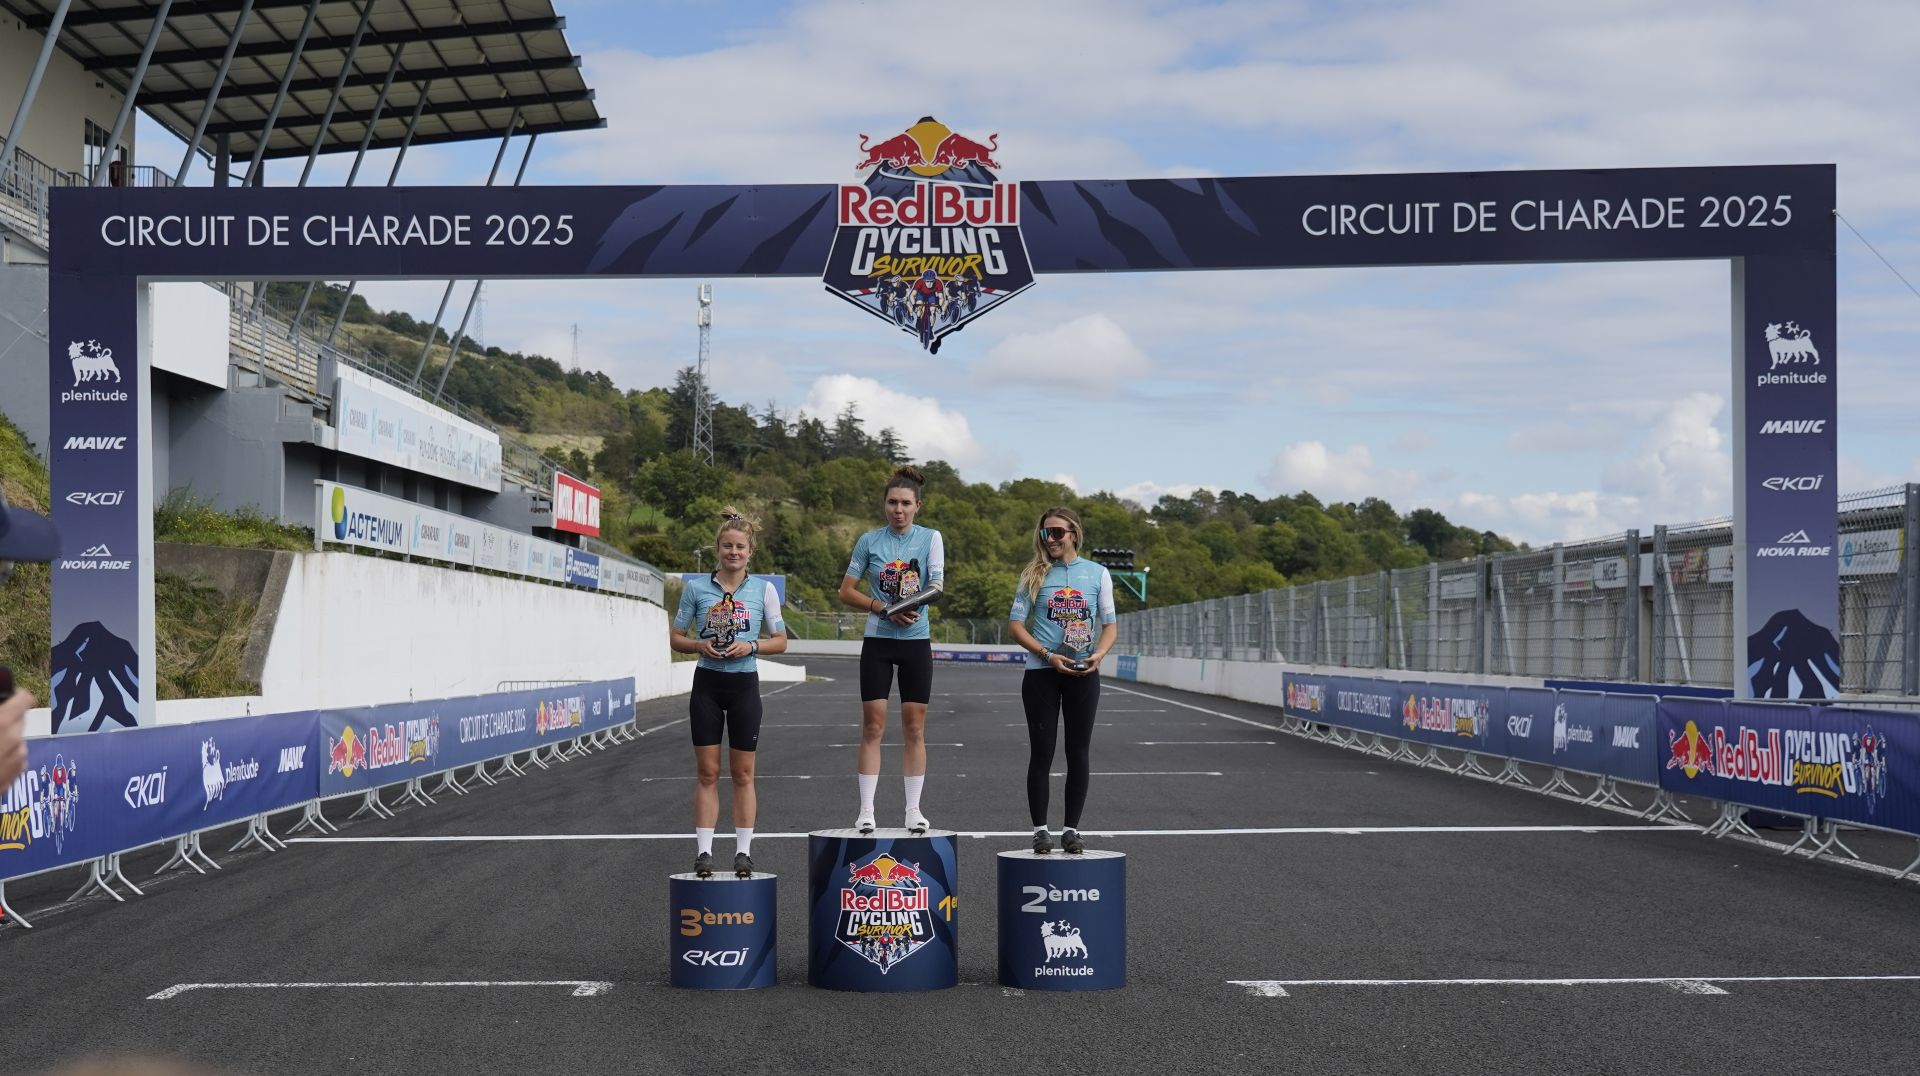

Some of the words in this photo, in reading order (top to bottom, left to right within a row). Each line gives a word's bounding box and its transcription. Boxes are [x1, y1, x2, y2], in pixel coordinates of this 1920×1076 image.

[841, 184, 926, 225] Red
[934, 182, 1018, 225] Bull
[1301, 202, 1440, 237] CIRCUIT
[1453, 201, 1497, 234] DE
[1510, 197, 1686, 233] CHARADE
[1699, 194, 1793, 229] 2025
[101, 214, 235, 247] CIRCUIT
[247, 215, 290, 246] DE
[302, 214, 472, 247] CHARADE
[485, 214, 575, 246] 2025
[850, 227, 1009, 277] CYCLING
[867, 253, 984, 281] SURVIVOR
[1757, 371, 1828, 387] plenitude
[61, 389, 129, 404] plenitude
[1759, 419, 1827, 434] MAVIC
[63, 436, 127, 450] MAVIC
[348, 511, 403, 547] ACTEMIUM
[1756, 547, 1796, 557] NOVA
[1797, 546, 1831, 556] RIDE
[61, 560, 97, 570] NOVA
[99, 560, 132, 570] RIDE
[880, 571, 898, 581] Red
[1048, 599, 1067, 608] Red
[1068, 598, 1088, 608] Bull
[1051, 607, 1083, 618] CYCLING
[460, 715, 481, 744] CIRCUIT
[481, 714, 489, 739] DE
[490, 710, 514, 738] CHARADE
[1421, 697, 1437, 730] Red
[1435, 698, 1452, 732] Bull
[1451, 699, 1479, 735] CYCLING
[369, 724, 389, 770] Red
[386, 721, 405, 766] Bull
[1567, 723, 1594, 744] plenitude
[1612, 725, 1640, 749] MAVIC
[278, 745, 307, 774] MAVIC
[1714, 725, 1748, 782] Red
[1746, 728, 1783, 786] Bull
[1784, 729, 1857, 794] CYCLING
[225, 758, 260, 783] plenitude
[1792, 759, 1845, 796] SURVIVOR
[841, 888, 885, 911] Red
[887, 887, 928, 911] Bull
[1021, 883, 1100, 914] 2ème
[681, 906, 755, 937] 3ème
[846, 911, 924, 936] CYCLING
[857, 923, 913, 938] SURVIVOR
[1034, 965, 1094, 978] plenitude
